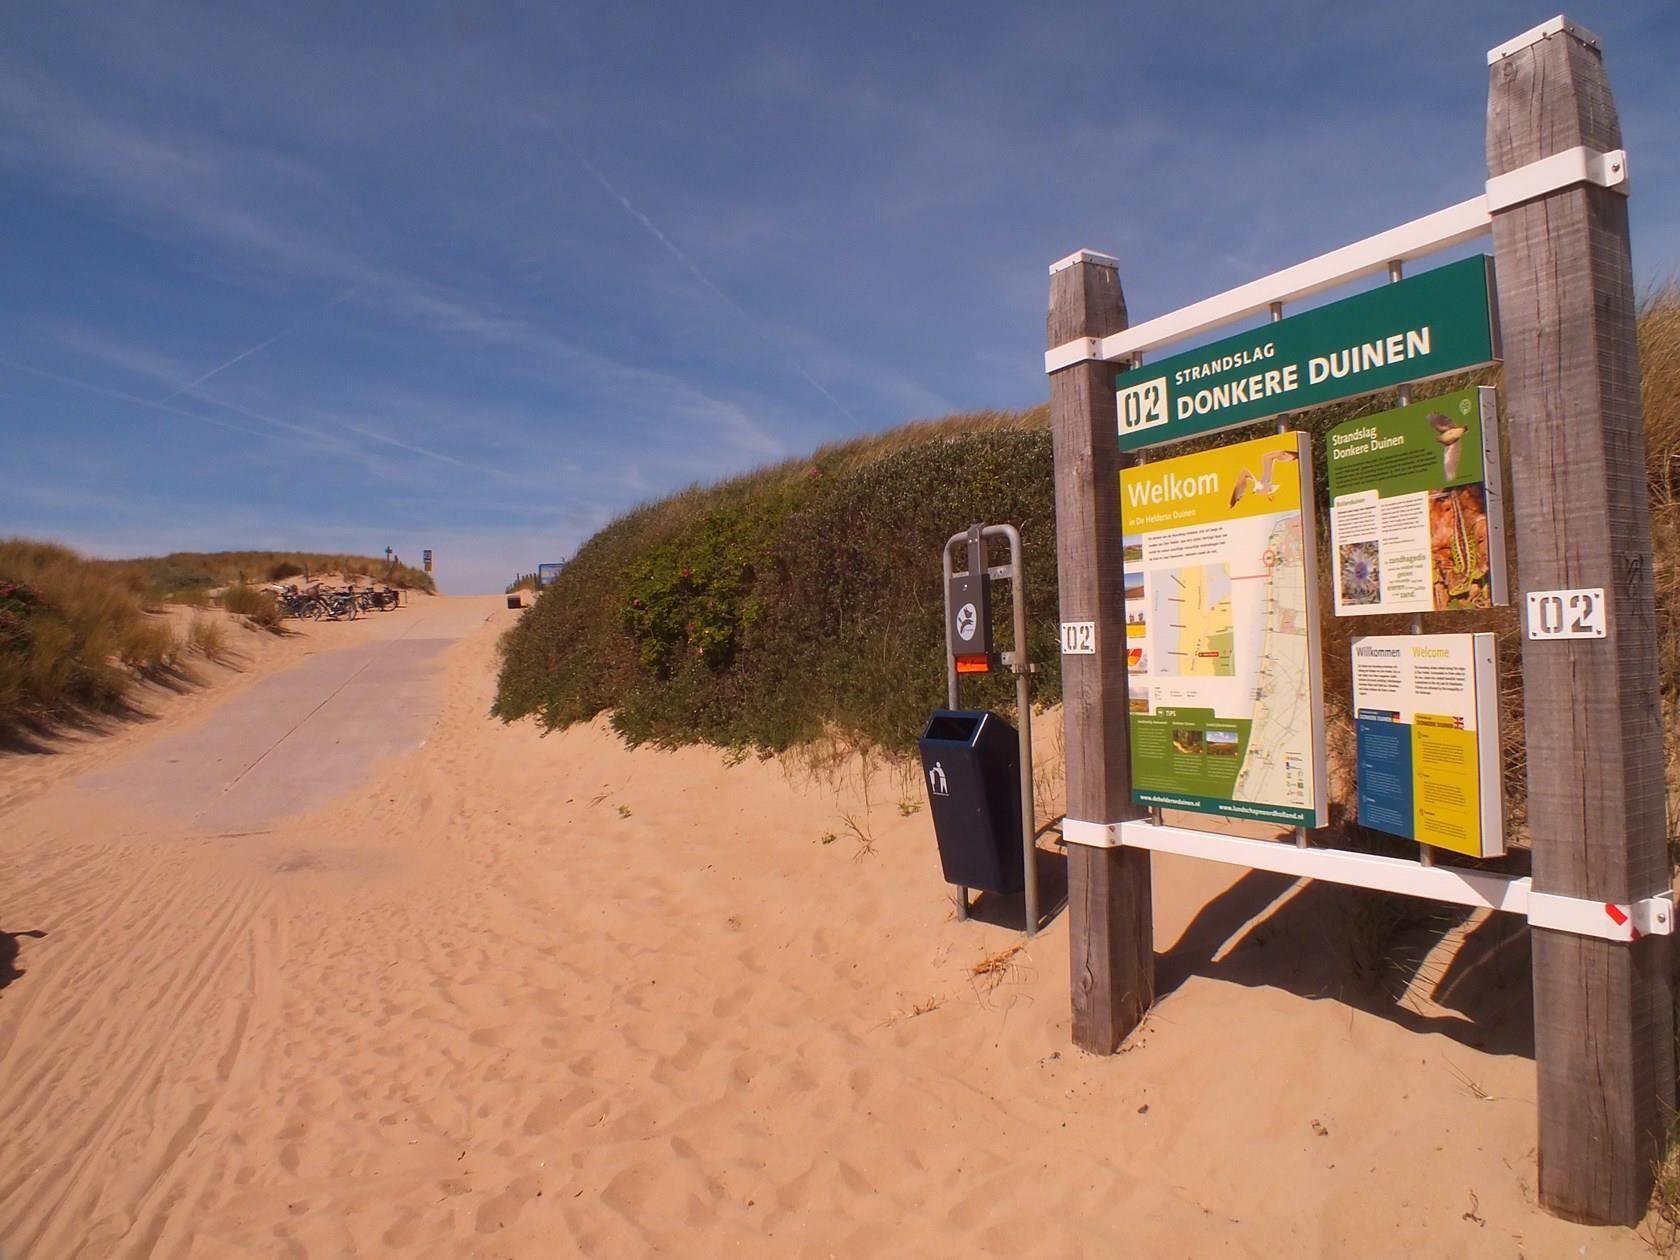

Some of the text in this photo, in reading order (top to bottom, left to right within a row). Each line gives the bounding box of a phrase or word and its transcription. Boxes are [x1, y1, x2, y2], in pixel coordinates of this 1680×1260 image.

[1175, 343, 1275, 385] STRANDSLAG
[1177, 326, 1431, 420] DONKERE DUINEN
[1125, 385, 1160, 427] 02
[1332, 426, 1377, 446] Strandslag
[1333, 435, 1405, 460] Donkere Duinen
[1128, 472, 1219, 508] Welkom
[1540, 595, 1593, 634] 02
[1067, 625, 1090, 650] 02
[1356, 646, 1401, 658] Willkommen
[1412, 646, 1449, 658] Welcome
